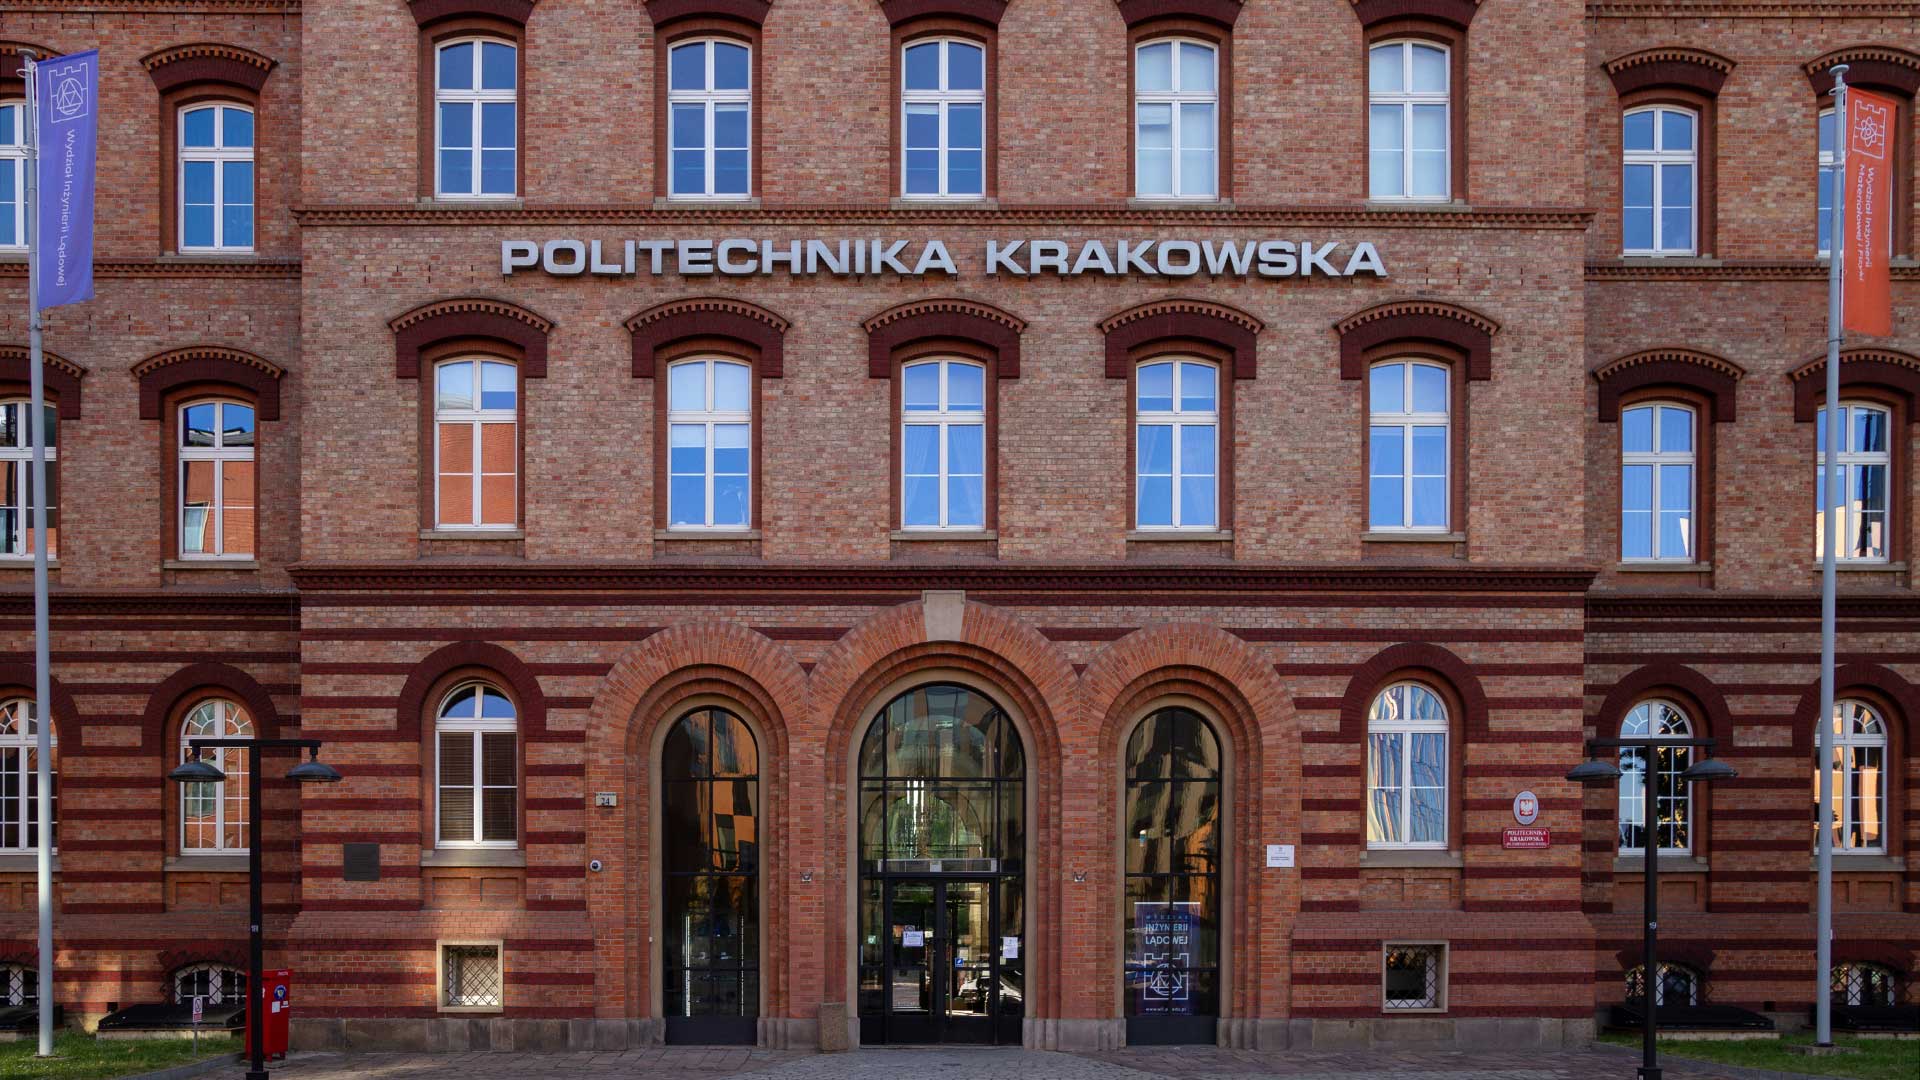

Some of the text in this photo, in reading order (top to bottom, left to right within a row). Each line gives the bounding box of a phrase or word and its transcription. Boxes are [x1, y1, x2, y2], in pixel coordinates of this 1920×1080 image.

[56, 128, 76, 286] Wydział Inżynierii Lądowej
[501, 239, 1388, 276] POLITECHNIKA KRAKOWSKA
[600, 797, 610, 806] 24
[1145, 922, 1188, 931] INŻYNERII
